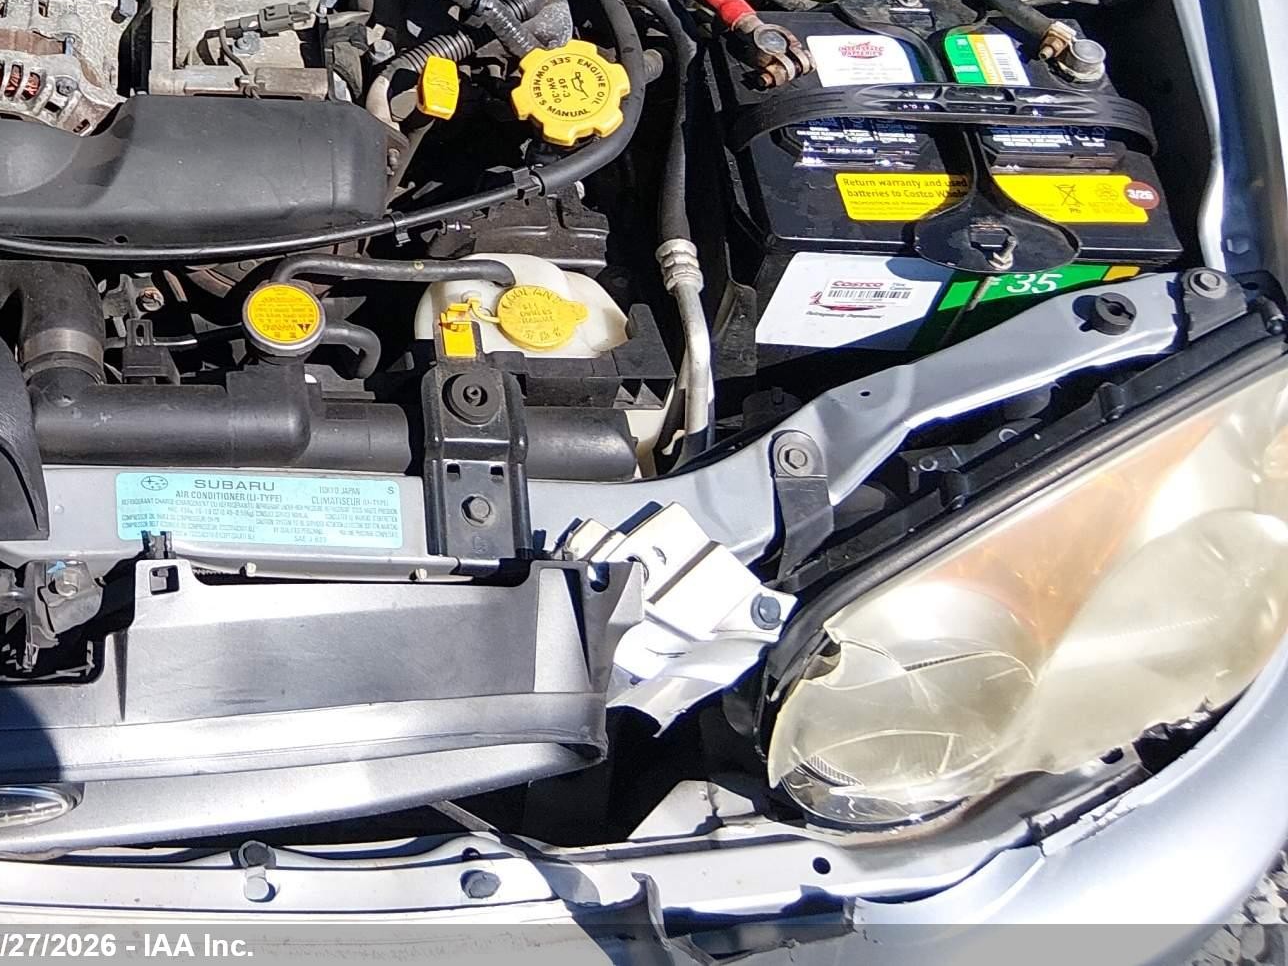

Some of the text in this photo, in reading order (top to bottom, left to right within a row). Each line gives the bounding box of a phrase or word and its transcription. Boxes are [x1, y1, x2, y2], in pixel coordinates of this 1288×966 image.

[550, 56, 571, 66] SEE
[577, 58, 606, 105] ENGINE OIL
[547, 105, 591, 117] MANUAL
[842, 178, 968, 189] Return warranty and used
[847, 189, 889, 198] batteries
[891, 190, 902, 198] to
[903, 189, 934, 198] Costco
[832, 280, 884, 288] COSTCO
[1006, 273, 1064, 294] 35
[194, 479, 275, 491] SUBARU
[175, 489, 189, 499] AIR
[191, 491, 245, 501] CONDITIONER
[342, 486, 361, 496] JAPAN
[311, 496, 361, 507] CLIMATISEUR
